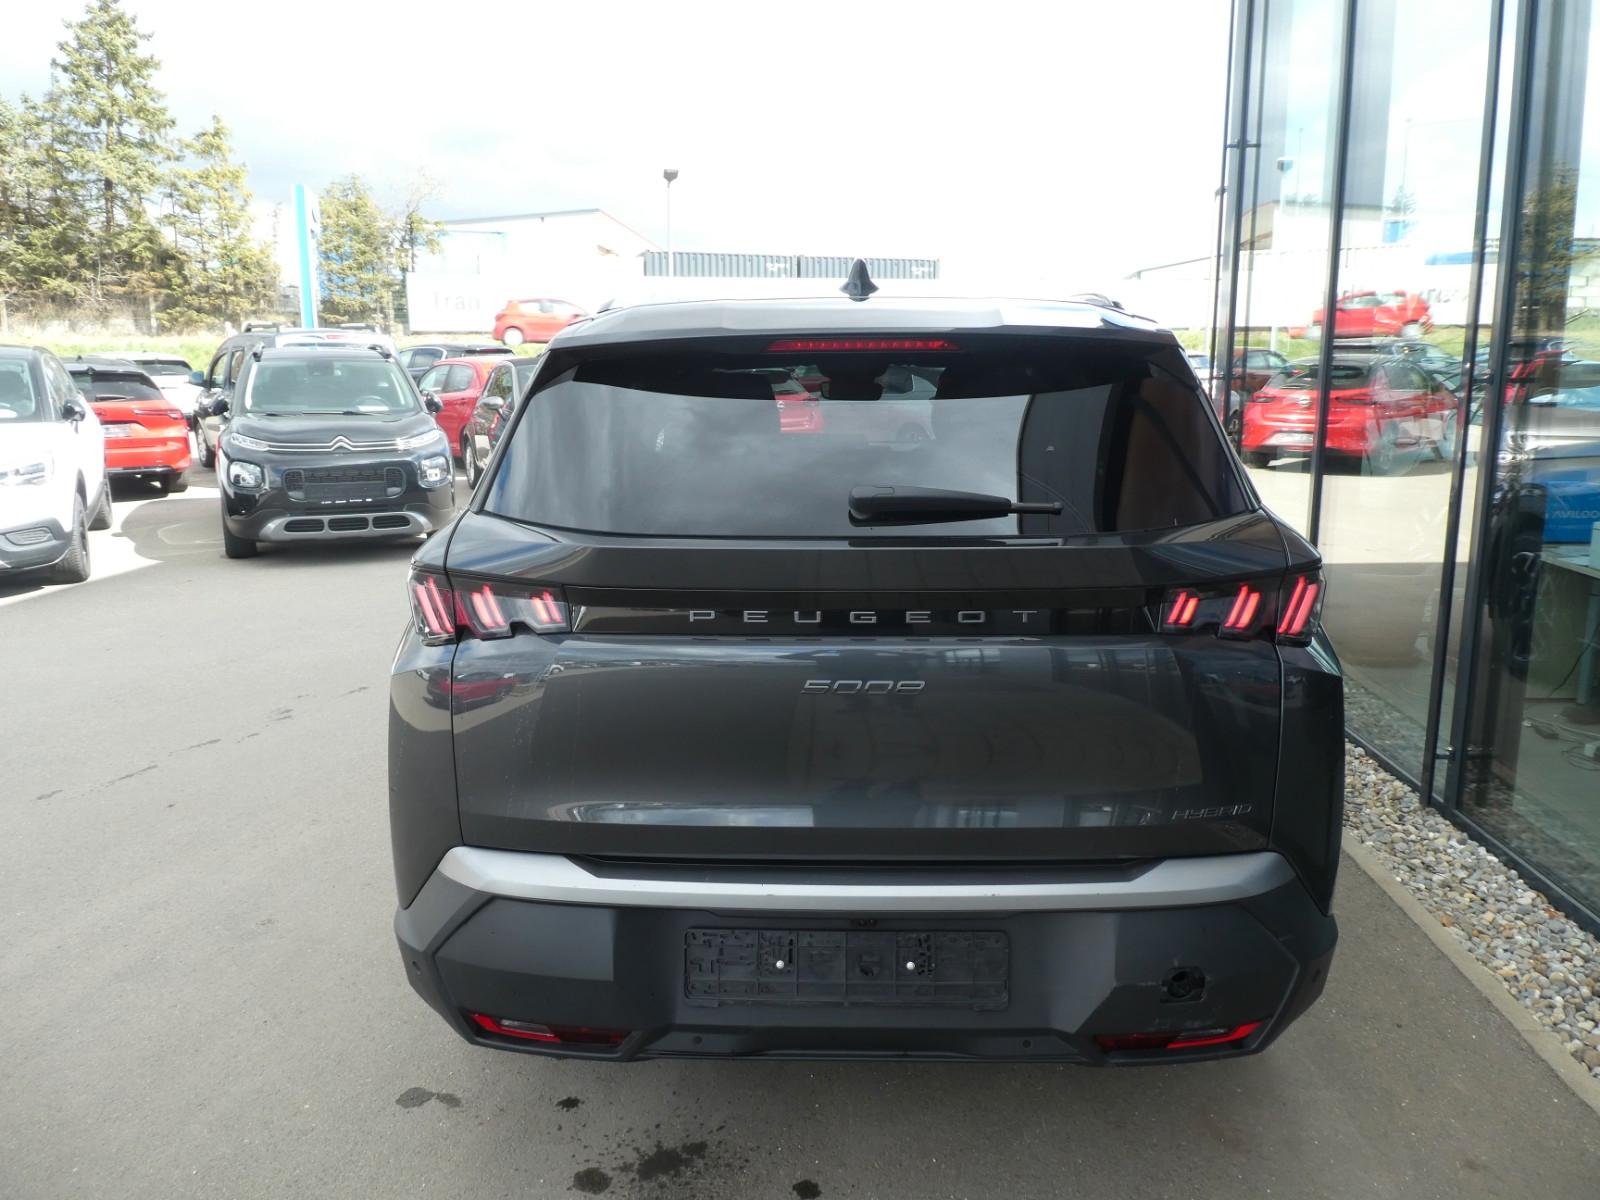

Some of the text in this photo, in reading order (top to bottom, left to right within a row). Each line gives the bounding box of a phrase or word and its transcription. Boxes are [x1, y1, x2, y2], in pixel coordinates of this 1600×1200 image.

[689, 610, 1038, 624] PEUGEOT
[800, 679, 926, 695] 5008
[1171, 804, 1252, 820] HYBRID
